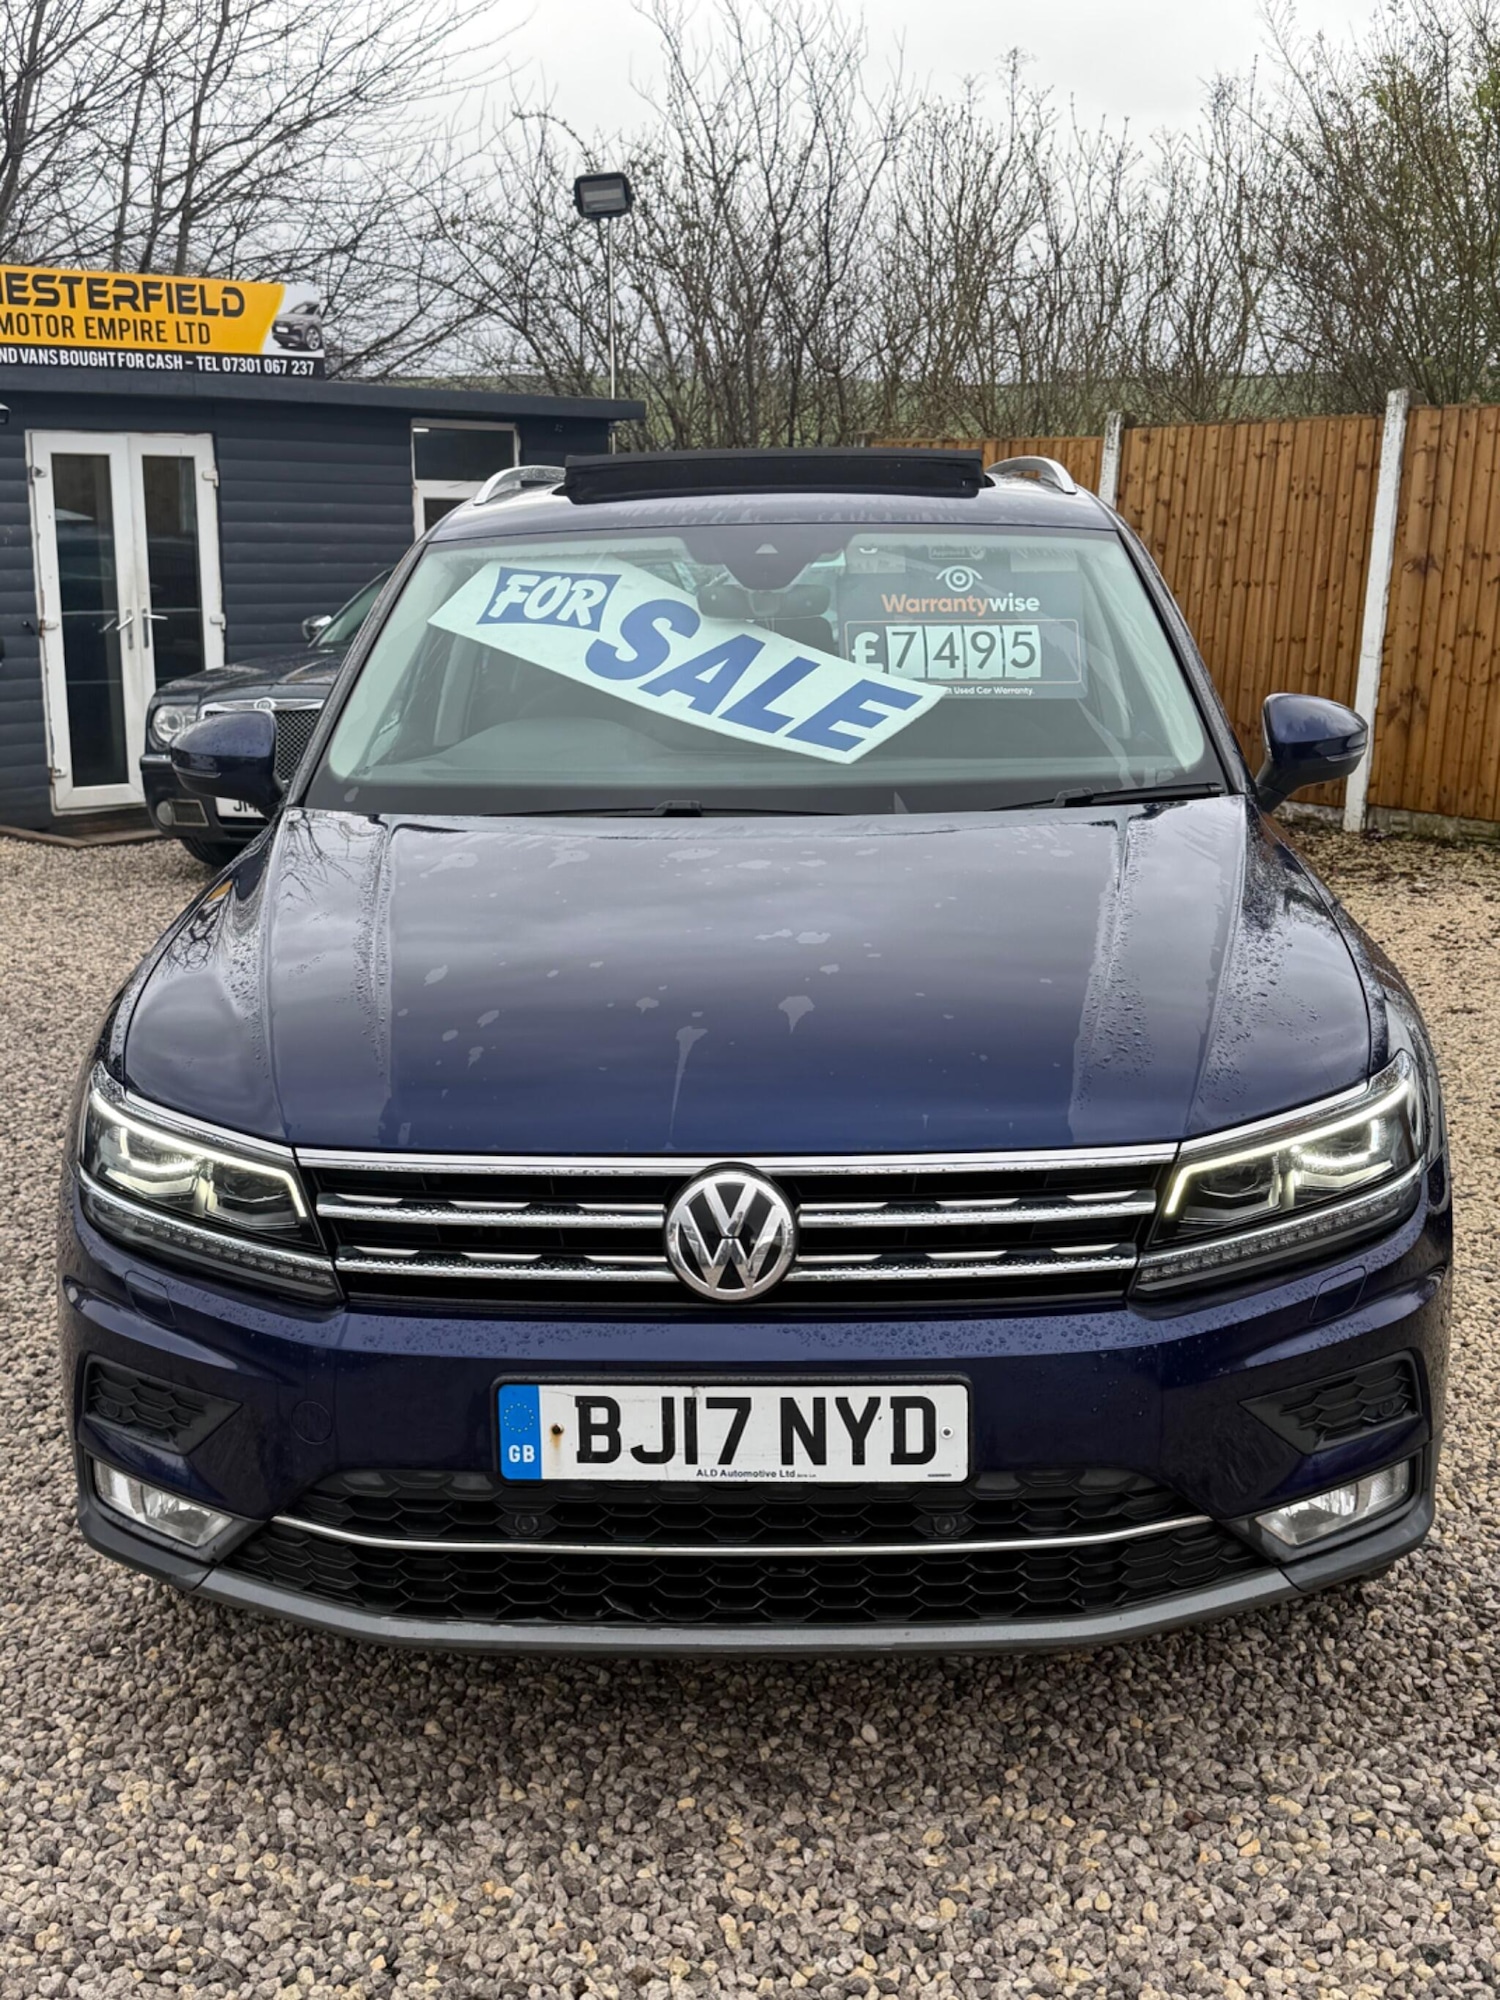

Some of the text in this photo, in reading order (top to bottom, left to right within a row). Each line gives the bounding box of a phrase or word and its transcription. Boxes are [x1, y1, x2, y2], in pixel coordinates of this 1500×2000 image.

[0, 271, 245, 318] ESTERFIELD
[0, 312, 211, 345] MOTOR EMPIRE LTD
[20, 348, 58, 365] VANS
[60, 350, 117, 367] BOUGHT
[118, 353, 145, 368] FOR
[146, 353, 183, 370] CASH
[196, 355, 220, 371] TEL
[222, 357, 262, 373] 07301
[264, 359, 287, 374] 067
[291, 361, 314, 376] 237
[881, 593, 1041, 617] Warrantywise
[488, 573, 924, 752] FOR SALE
[851, 630, 1037, 674] £7495
[953, 686, 976, 695] Used
[976, 686, 992, 695] Car
[574, 1395, 937, 1466] BJ17 NYD
[507, 1444, 536, 1464] GB
[696, 1469, 718, 1478] ALD
[720, 1469, 777, 1478] Automotive
[779, 1469, 796, 1478] Ltd
